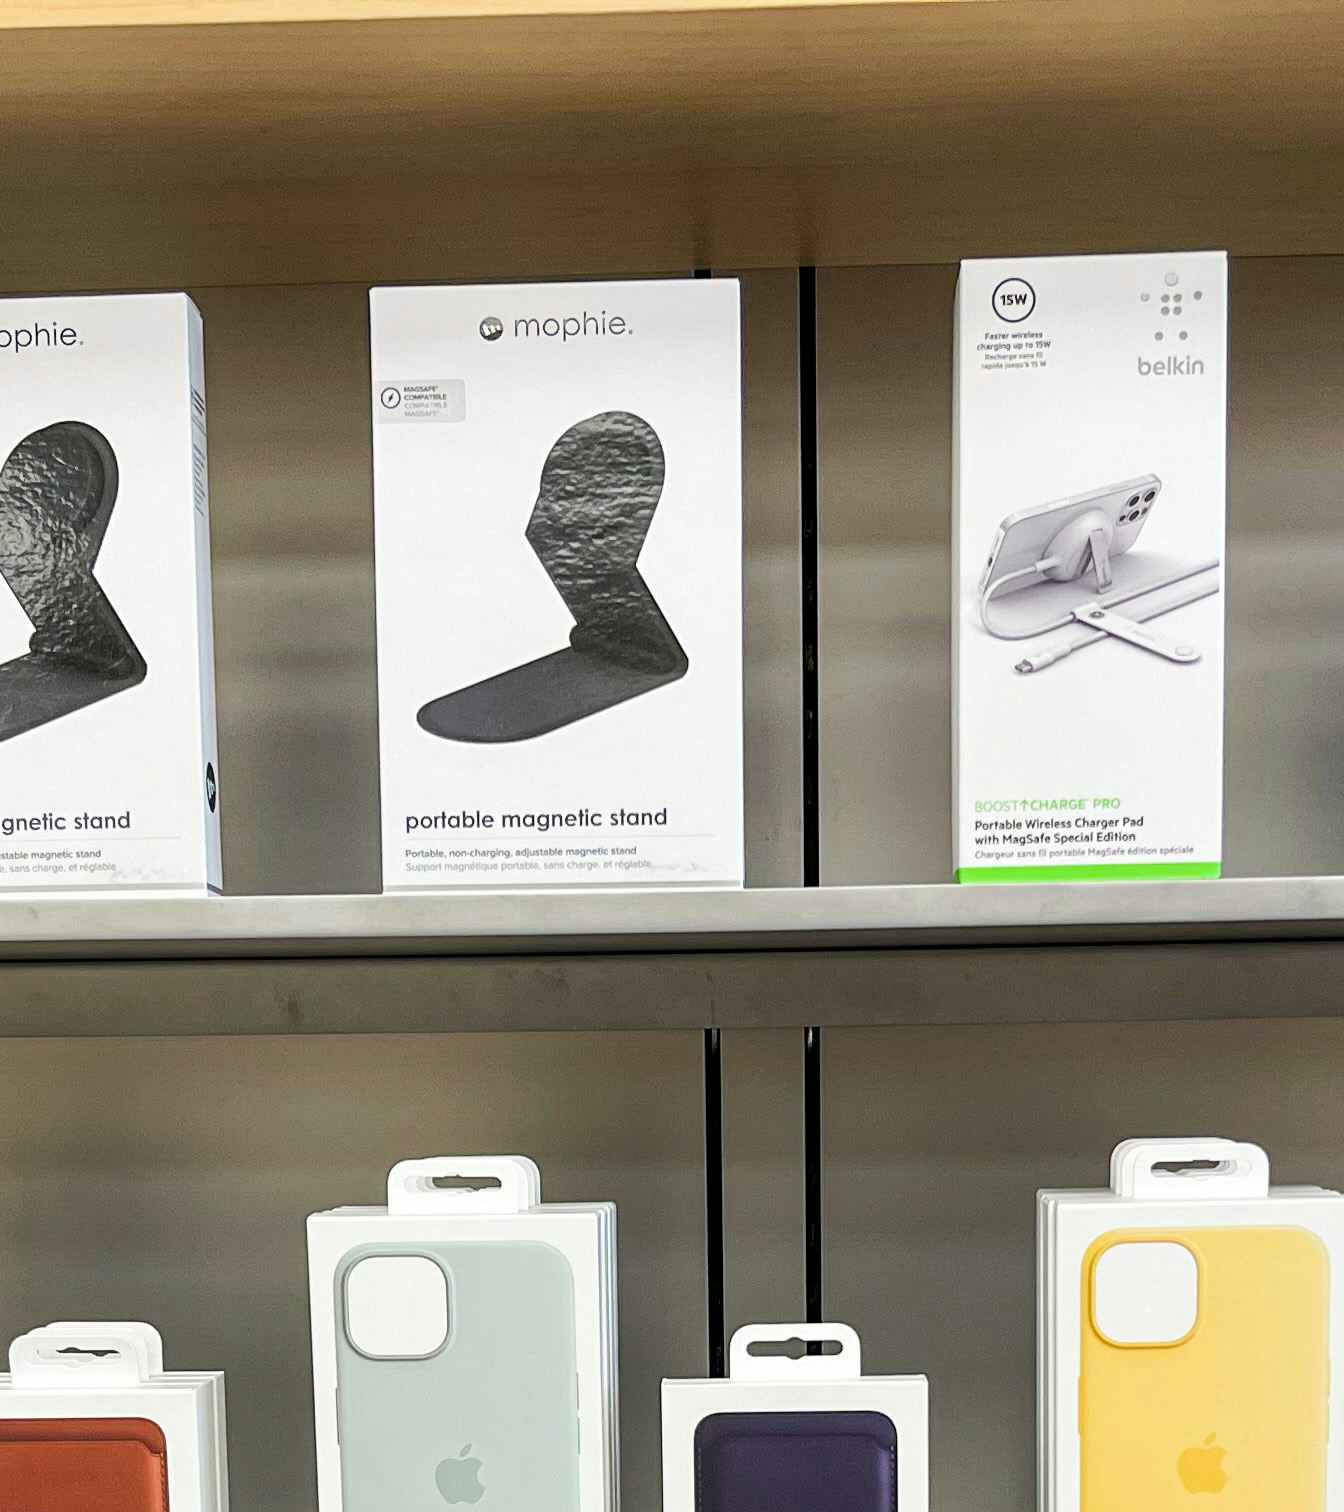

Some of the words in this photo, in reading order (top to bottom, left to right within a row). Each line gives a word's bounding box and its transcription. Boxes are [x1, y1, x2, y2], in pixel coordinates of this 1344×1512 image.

[1001, 293, 1027, 306] 15W
[985, 332, 1009, 340] Faster
[1011, 331, 1042, 339] wireless
[977, 342, 1010, 351] charging
[1138, 356, 1204, 375] belkin
[1093, 798, 1120, 809] PRO
[74, 812, 130, 830] stand
[406, 811, 494, 833] portable
[502, 809, 602, 831] magnetic
[610, 808, 667, 826] stand
[975, 820, 1022, 830] Portable
[1026, 819, 1072, 829] Wireless
[1075, 818, 1118, 829] Charger
[1123, 817, 1144, 827] Pad
[975, 835, 999, 845] with
[1003, 834, 1051, 846] MagSafe
[1054, 833, 1093, 844] Special
[1096, 832, 1135, 843] Edition
[31, 850, 73, 860] magnetic
[76, 849, 101, 858] stand
[515, 847, 562, 857] adjustable
[566, 847, 608, 857] magnetic
[611, 846, 637, 855] stand
